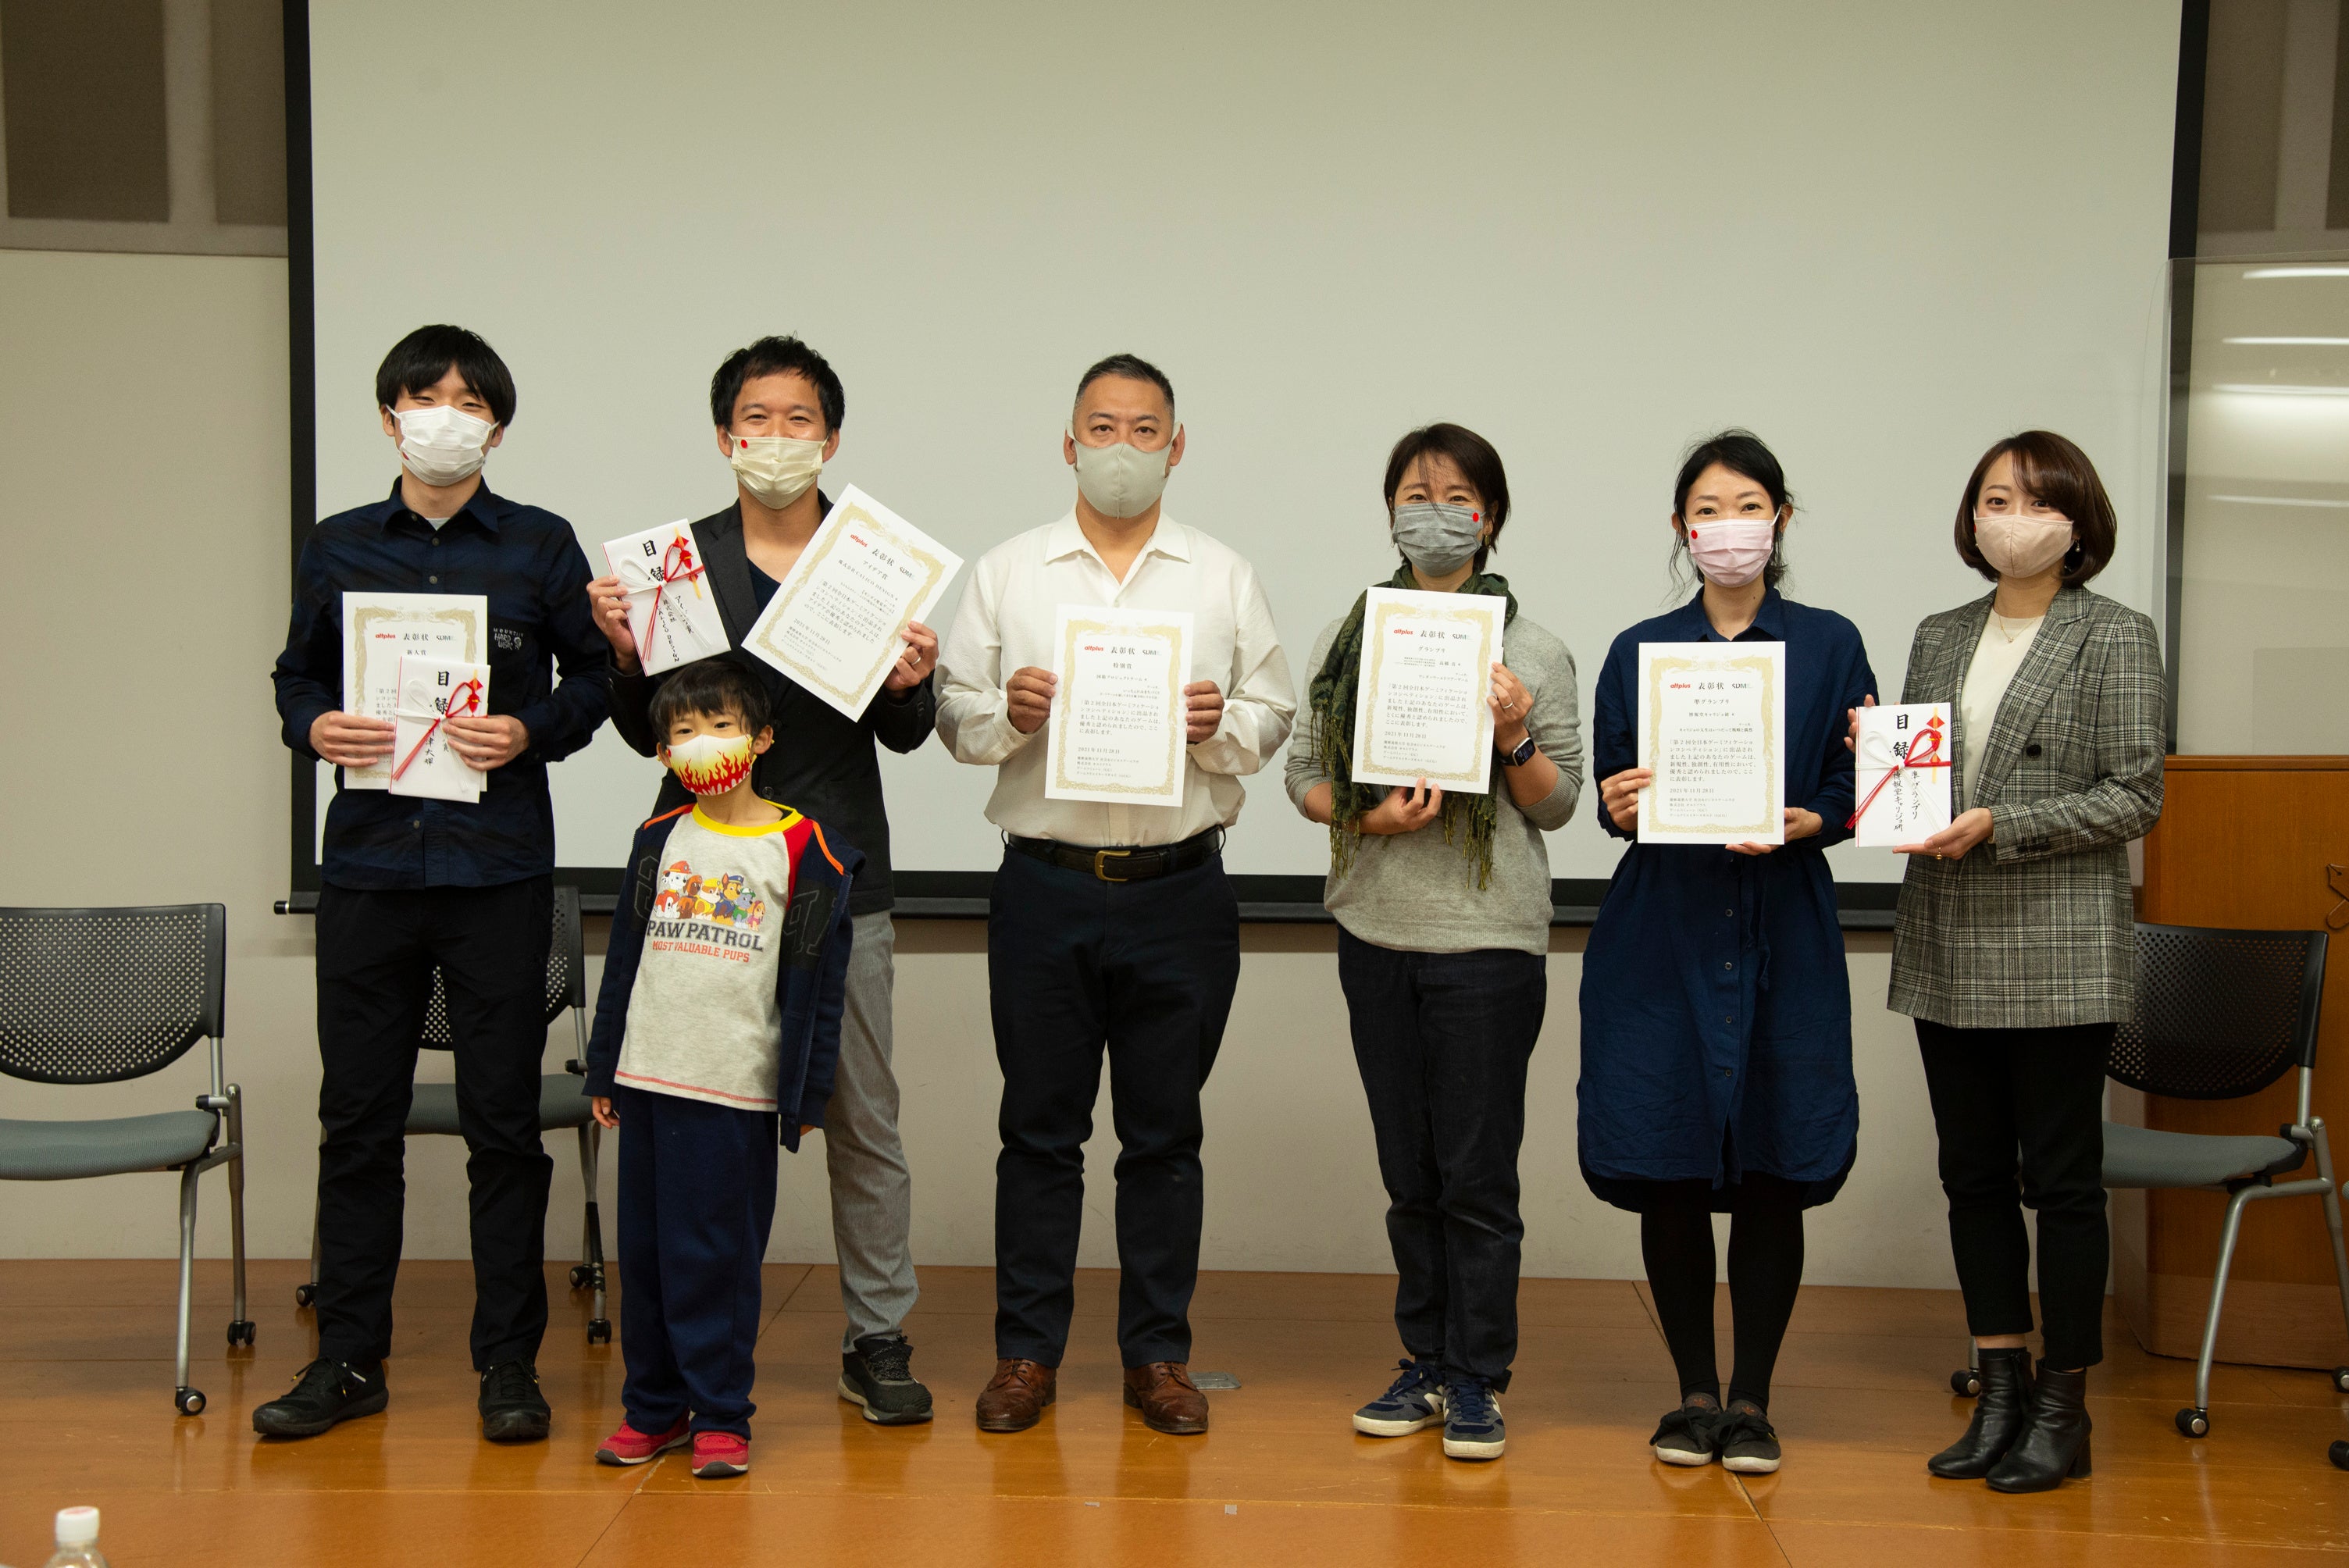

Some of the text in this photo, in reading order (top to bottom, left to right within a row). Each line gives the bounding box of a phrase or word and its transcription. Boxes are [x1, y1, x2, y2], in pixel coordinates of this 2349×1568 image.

[872, 547, 896, 566] 表彰状
[1420, 630, 1445, 639] 表彰状
[1110, 647, 1135, 655] 表彰状
[1893, 714, 1909, 759] 目録
[647, 920, 763, 952] PAW PATROL
[652, 940, 750, 963] MOST VALUABLE PUPS
